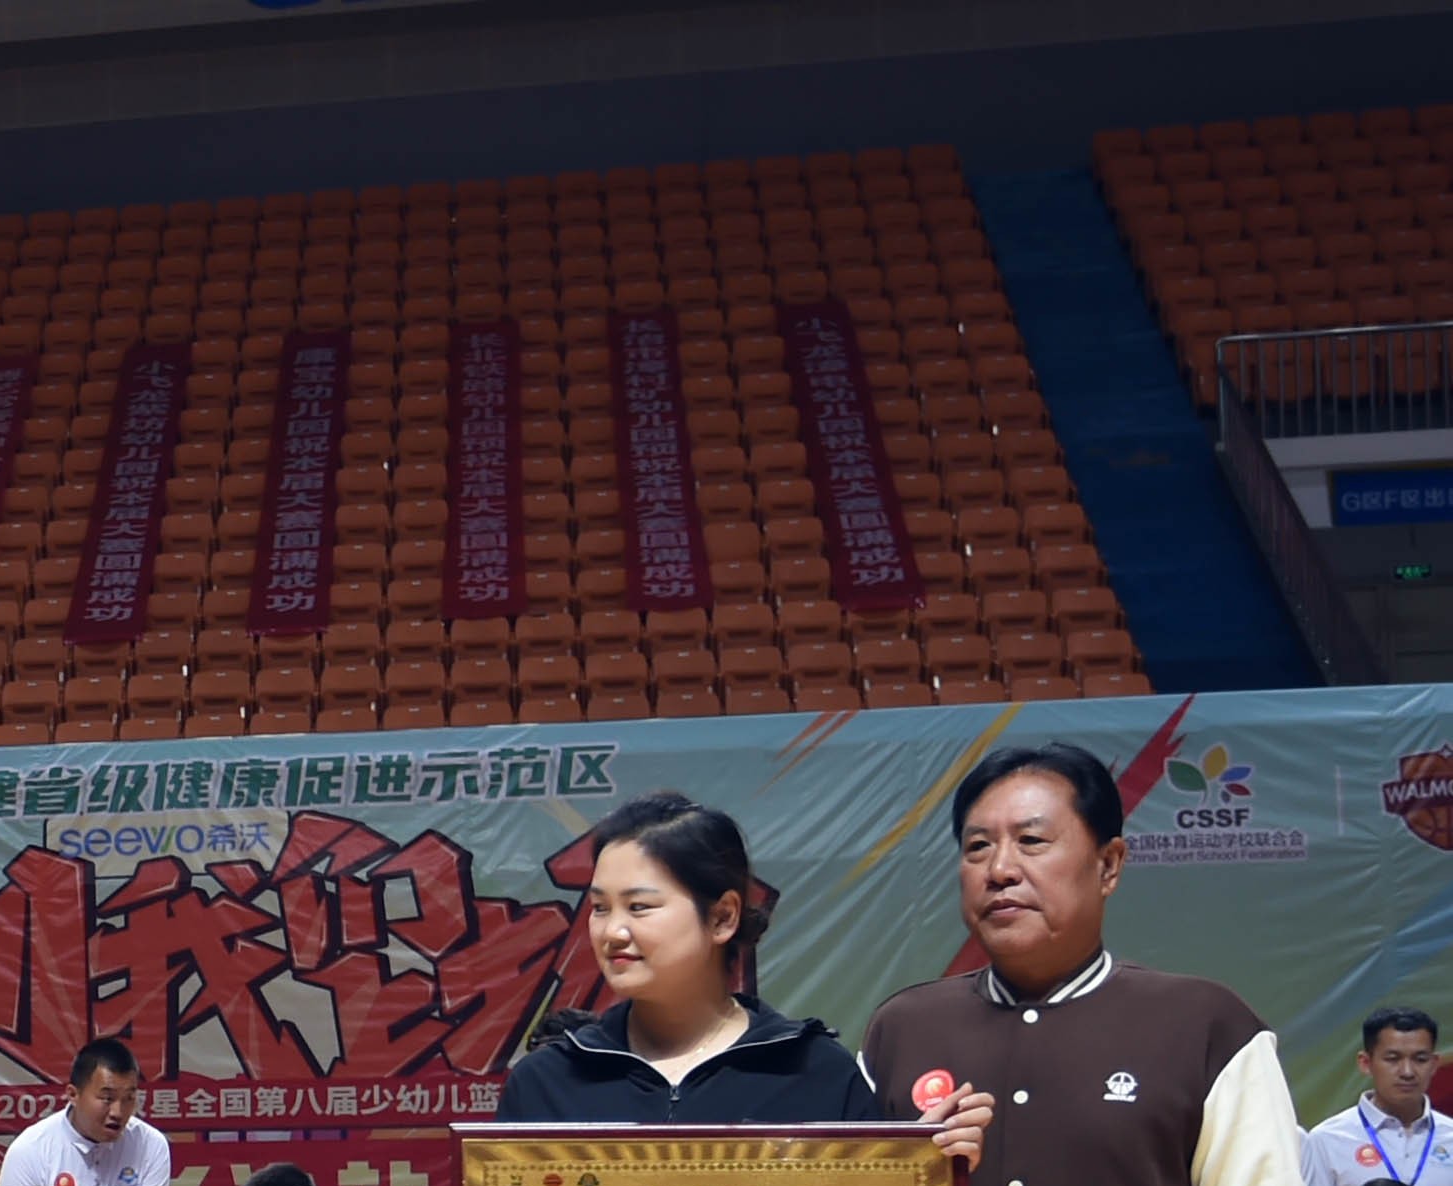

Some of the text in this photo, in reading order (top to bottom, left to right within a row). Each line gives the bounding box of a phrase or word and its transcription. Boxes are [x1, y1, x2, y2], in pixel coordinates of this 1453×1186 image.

[1340, 487, 1453, 512] G区F区出
[1177, 808, 1251, 830] CSSF
[206, 821, 270, 852] 希沃
